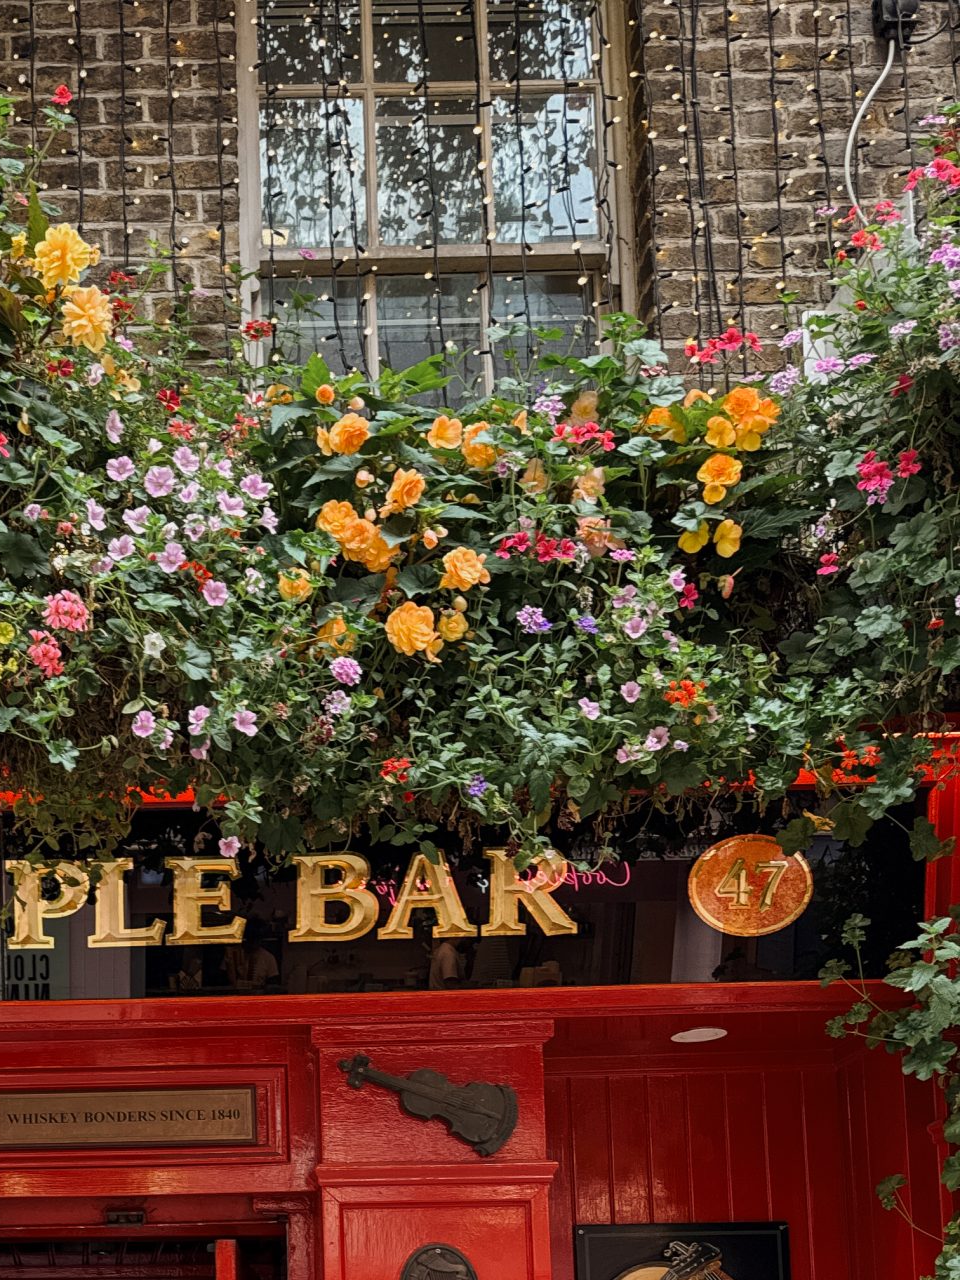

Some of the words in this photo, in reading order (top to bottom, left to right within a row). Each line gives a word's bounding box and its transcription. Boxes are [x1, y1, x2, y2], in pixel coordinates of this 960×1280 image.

[288, 847, 578, 942] BAR
[714, 858, 789, 913] 47
[7, 1112, 78, 1125] WHISKEY
[84, 1110, 156, 1123] BONDERS
[160, 1109, 206, 1122] SINCE
[210, 1109, 240, 1121] 1840
